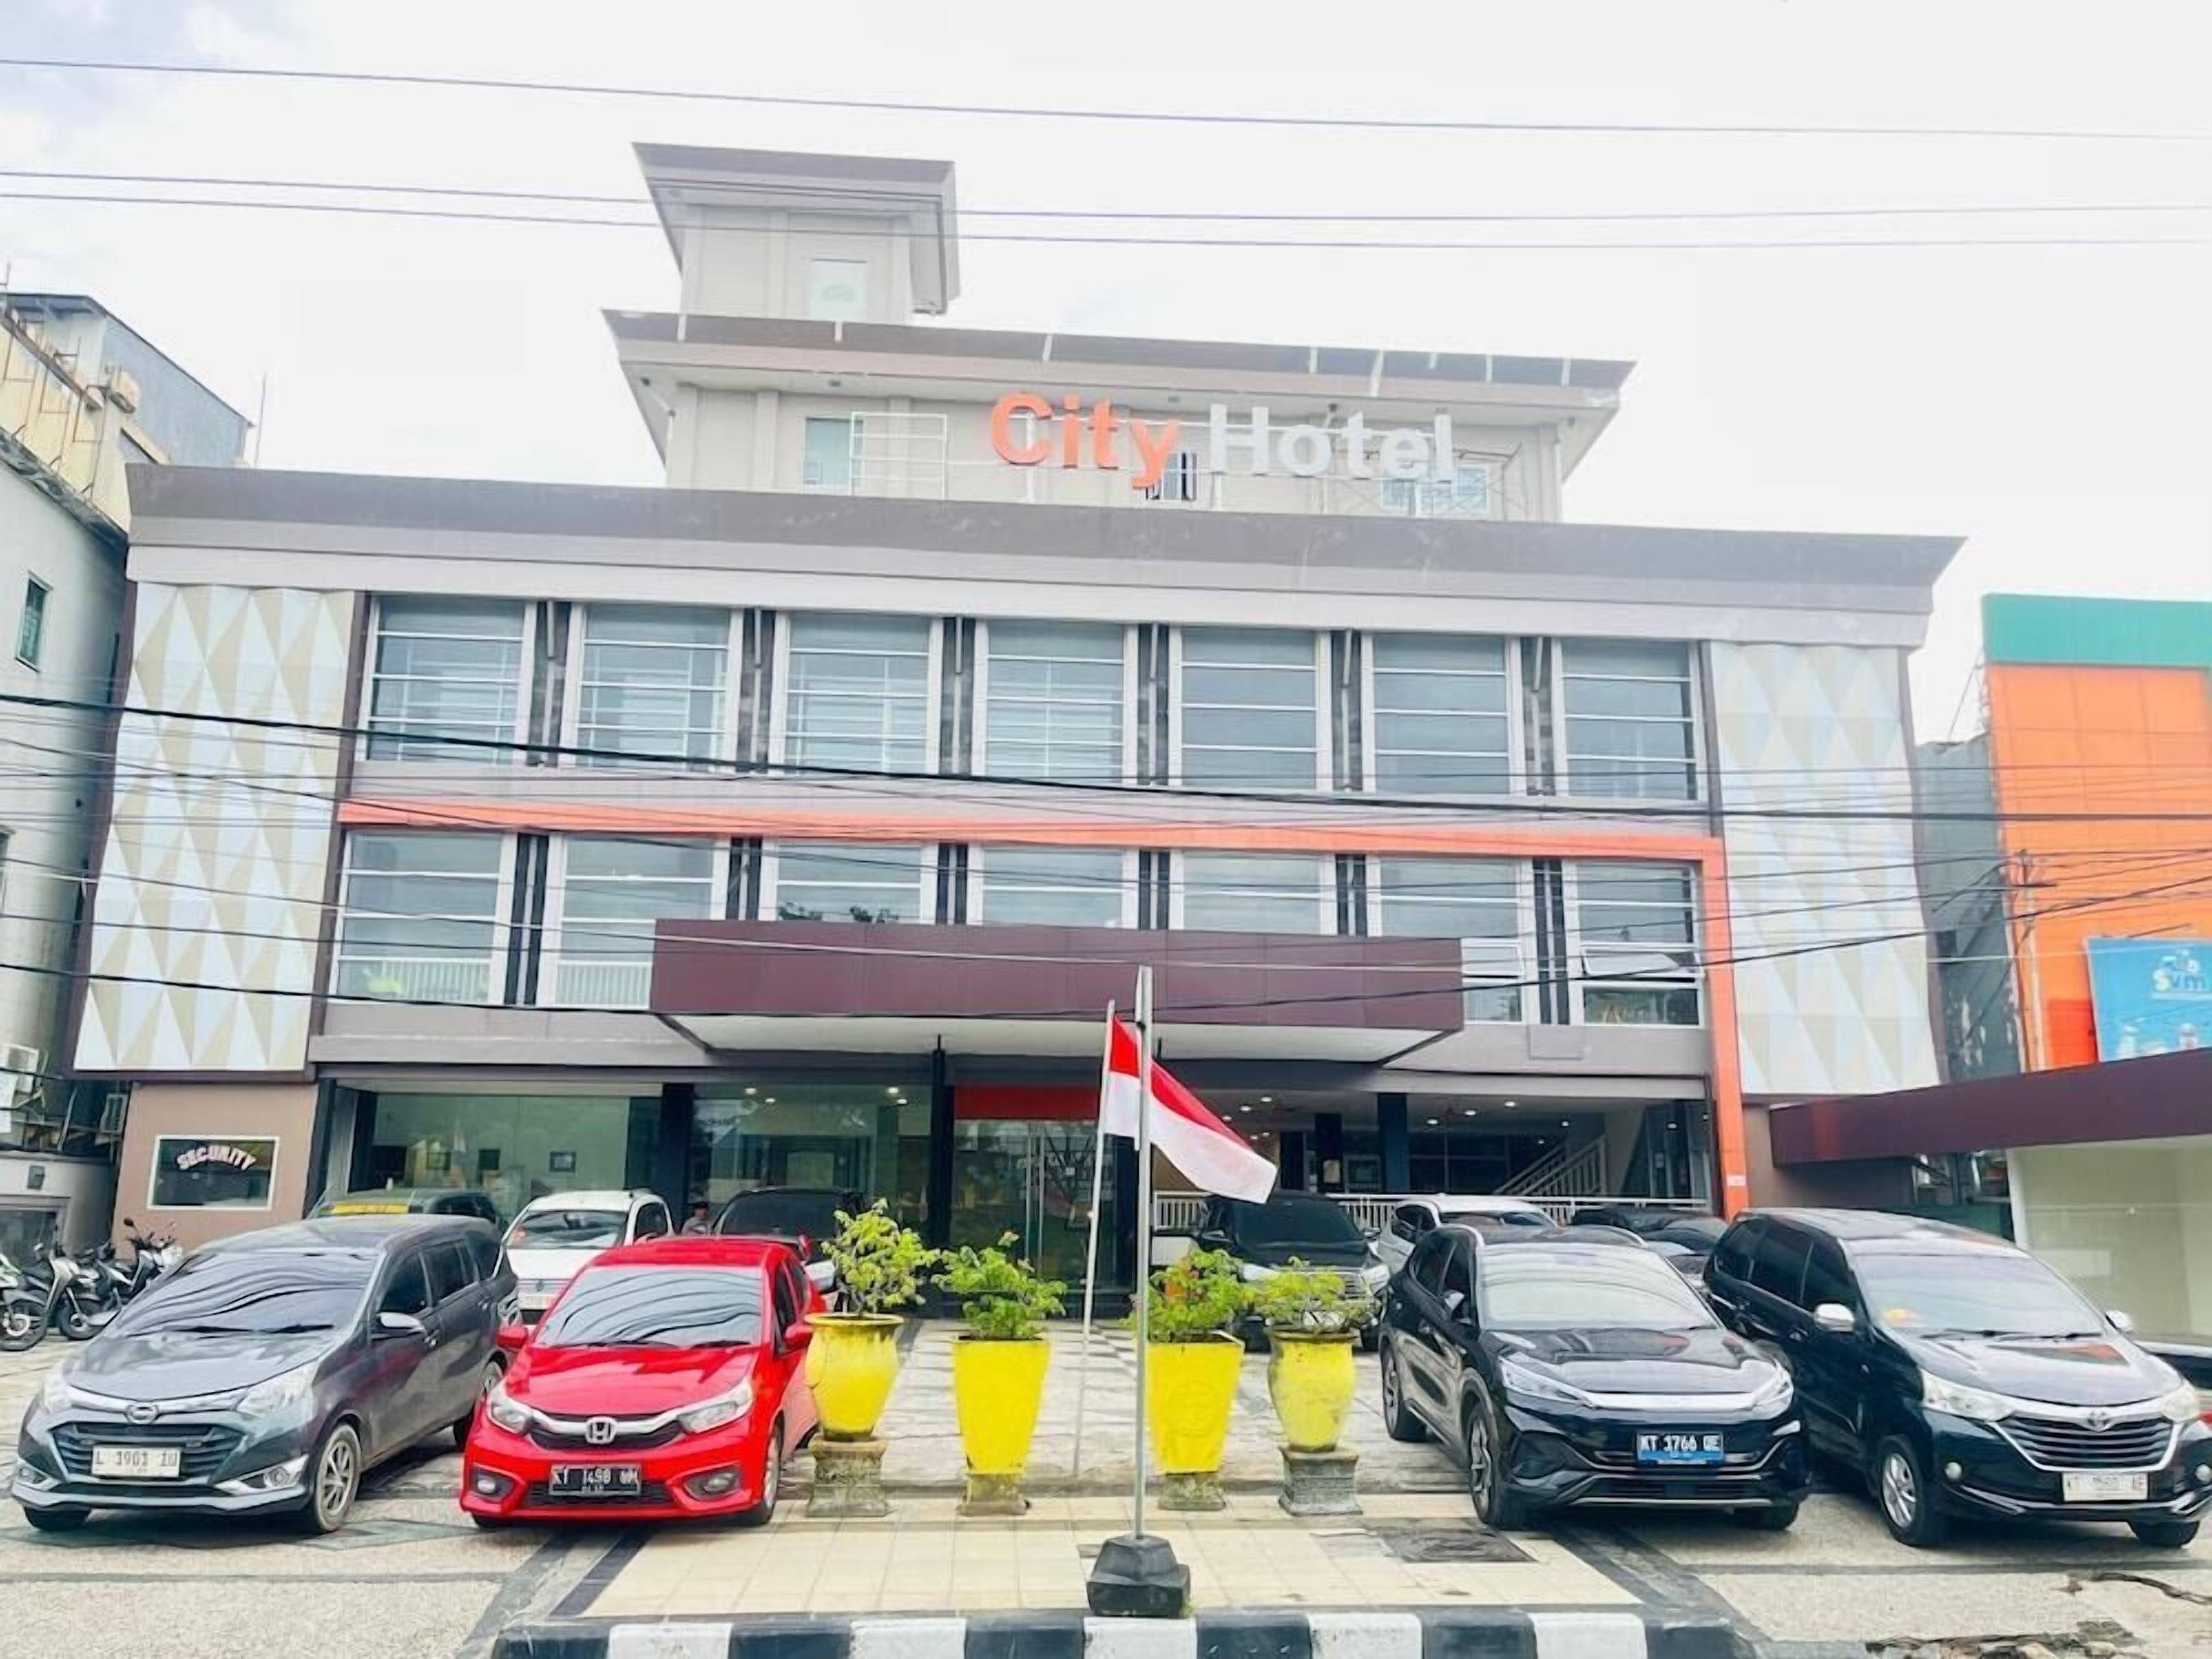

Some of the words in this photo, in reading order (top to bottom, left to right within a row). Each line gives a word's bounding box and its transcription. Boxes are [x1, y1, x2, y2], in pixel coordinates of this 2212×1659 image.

[990, 392, 1180, 489] City
[1209, 403, 1458, 483] Hotel
[176, 1145, 257, 1171] SECURITY
